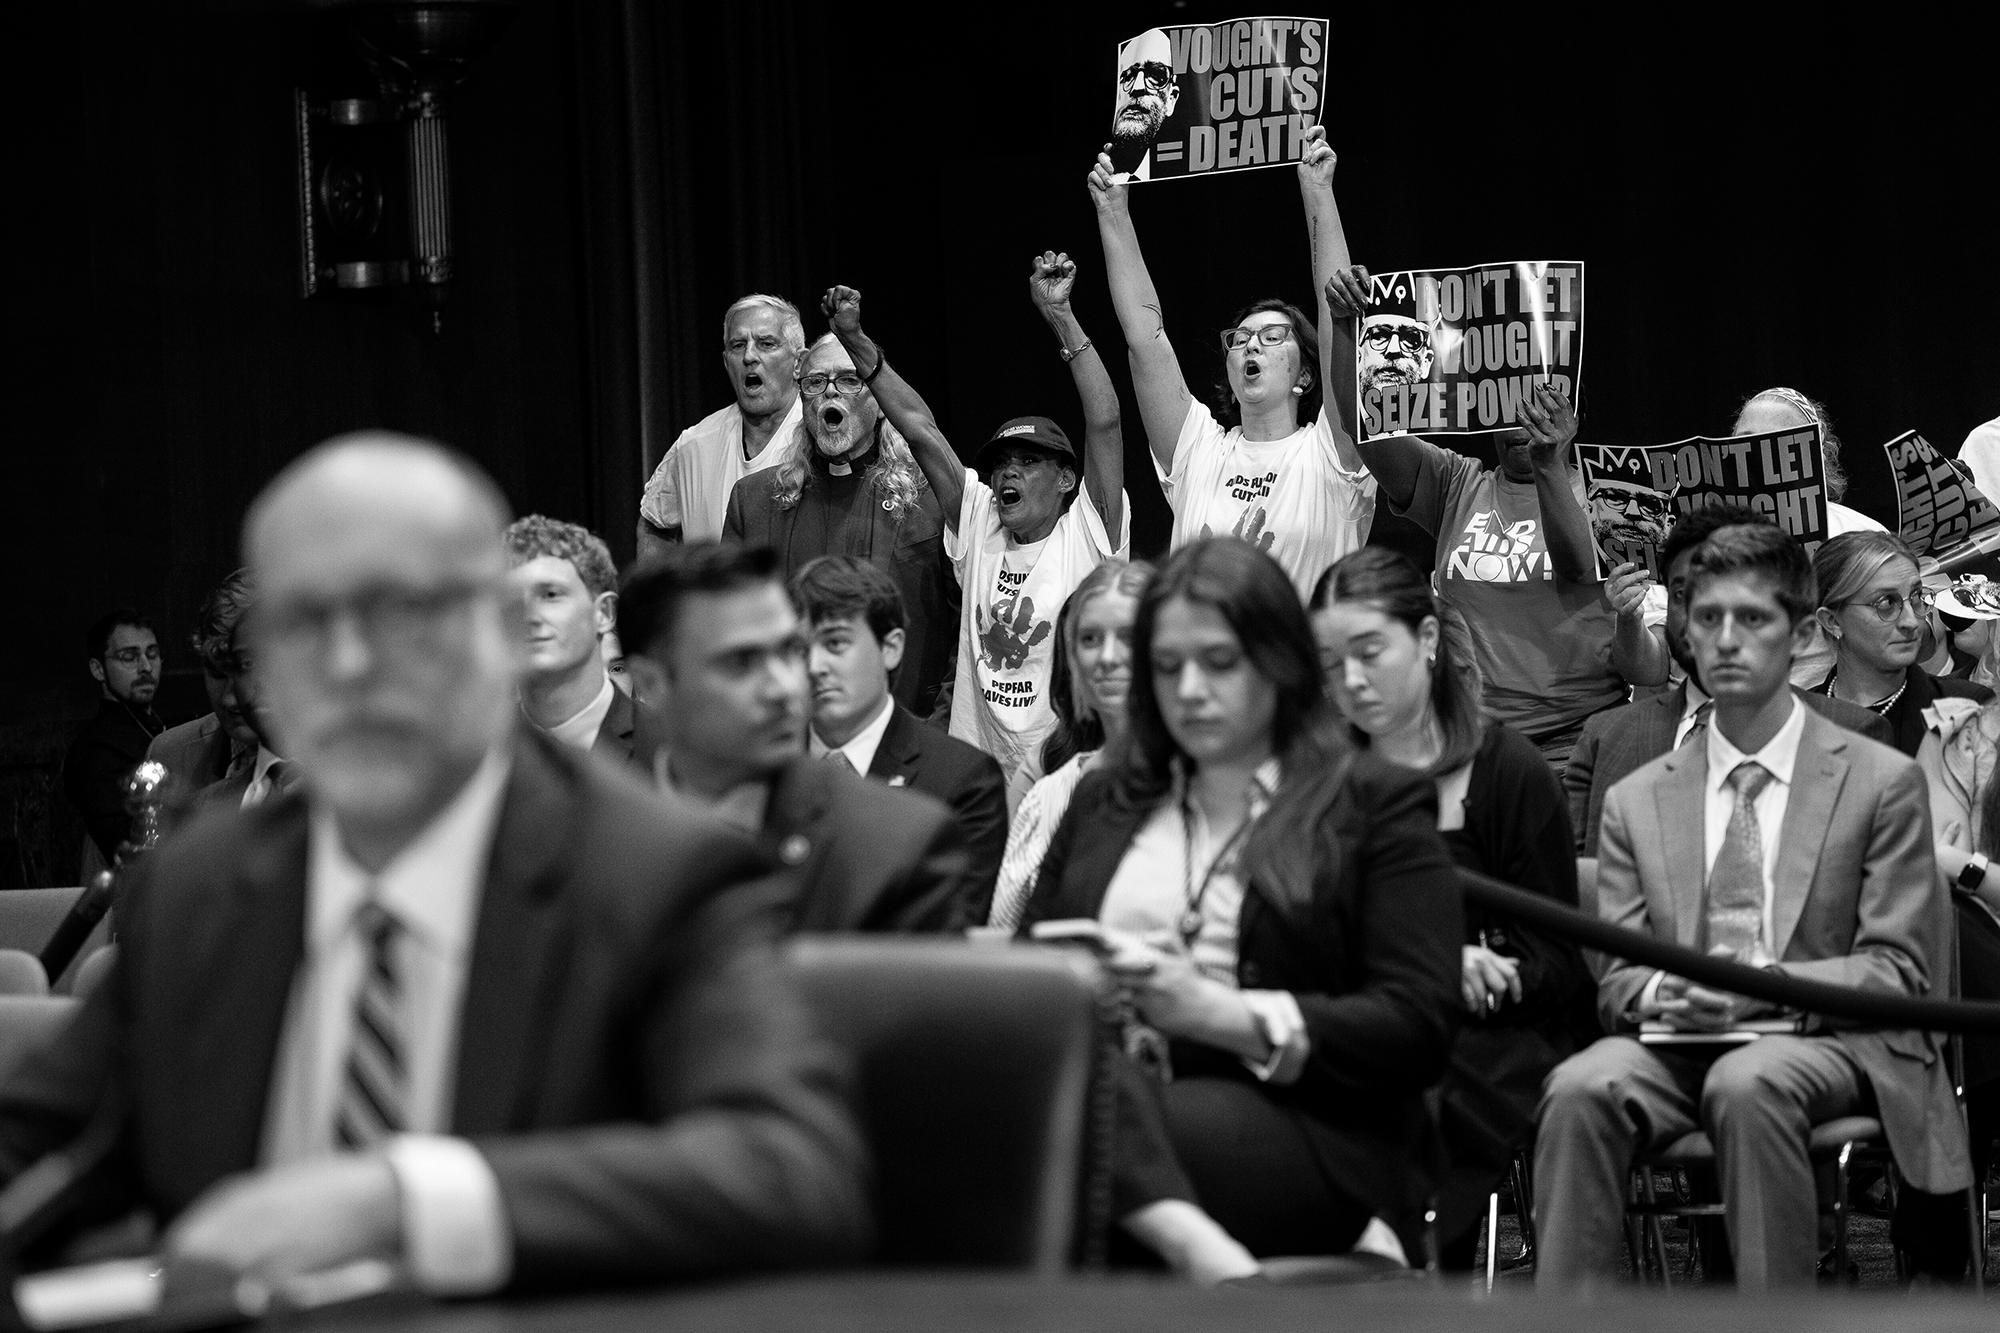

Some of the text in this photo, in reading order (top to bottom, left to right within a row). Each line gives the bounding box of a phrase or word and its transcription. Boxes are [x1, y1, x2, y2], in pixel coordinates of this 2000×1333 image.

[1170, 20, 1322, 75] VOUGHT'S
[1210, 67, 1319, 121] CUTS
[1189, 114, 1316, 172] DEATH
[1415, 268, 1577, 322] DON'T LET
[1434, 321, 1577, 375] VOUGHT
[1365, 383, 1448, 436] SEIZE
[1225, 475, 1250, 487] ADS
[1650, 431, 1815, 490] DON'T LET
[997, 581, 1019, 597] UTS
[1447, 551, 1553, 583] NOW!
[981, 688, 1012, 707] AVES
[992, 680, 1033, 694] PEPFAR
